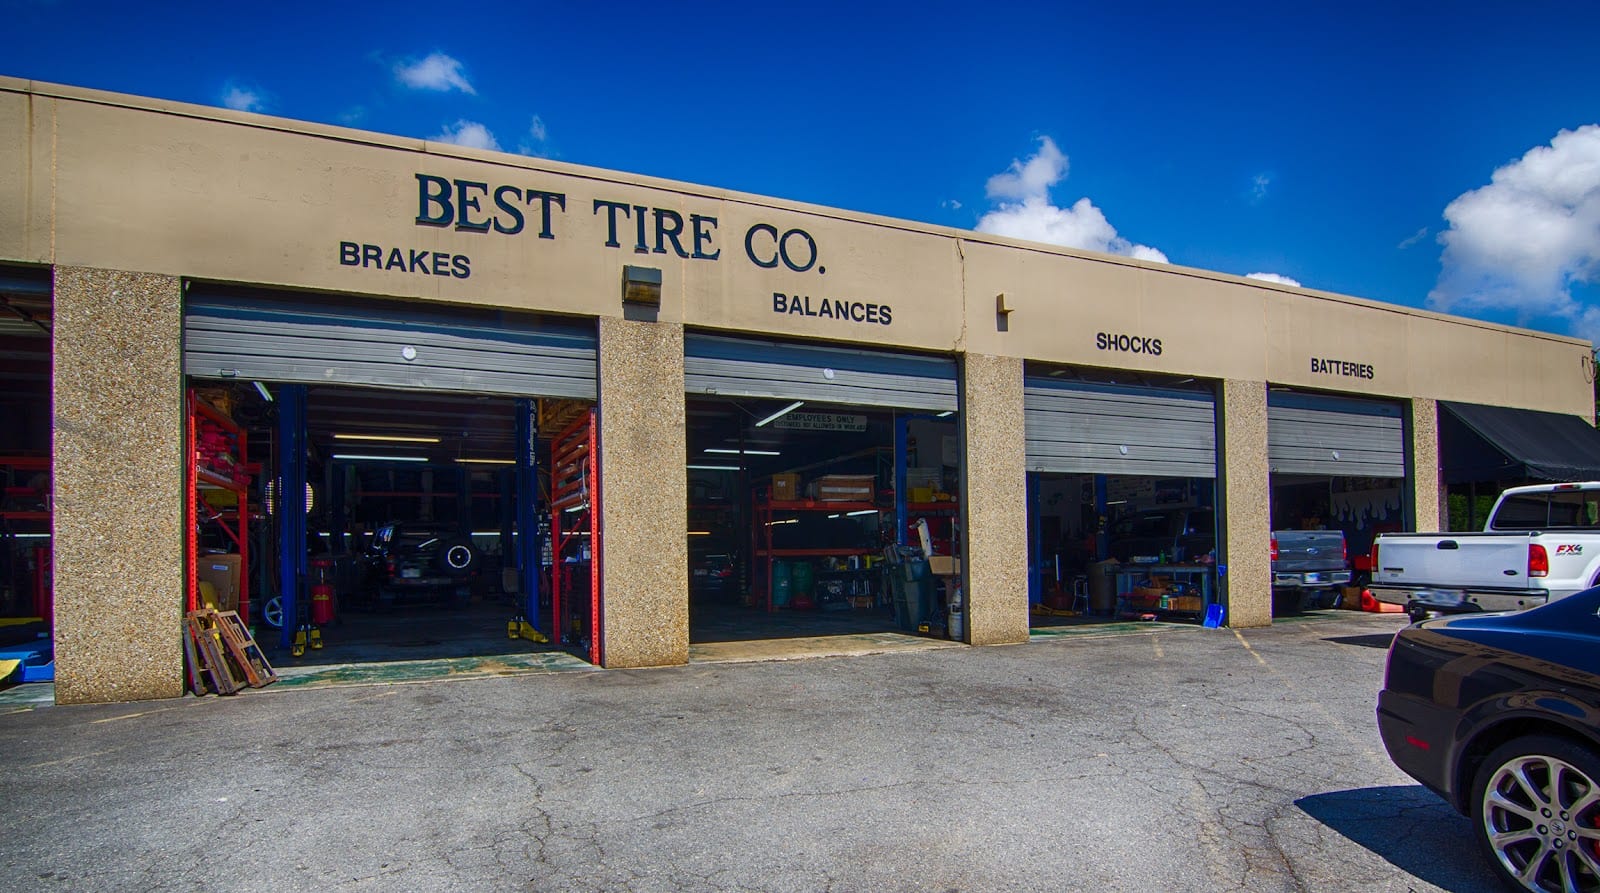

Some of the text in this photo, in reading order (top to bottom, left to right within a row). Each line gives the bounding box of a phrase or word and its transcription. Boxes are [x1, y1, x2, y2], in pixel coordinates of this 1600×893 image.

[415, 173, 827, 274] BEST TIRE CO.
[340, 241, 470, 279] BRAKES
[773, 293, 892, 325] BALANCES
[1097, 332, 1162, 356] SHOCKS
[1311, 358, 1374, 379] BATTERIES
[786, 414, 855, 424] EMPLOYEES ONLY
[1556, 544, 1583, 552] FX4
